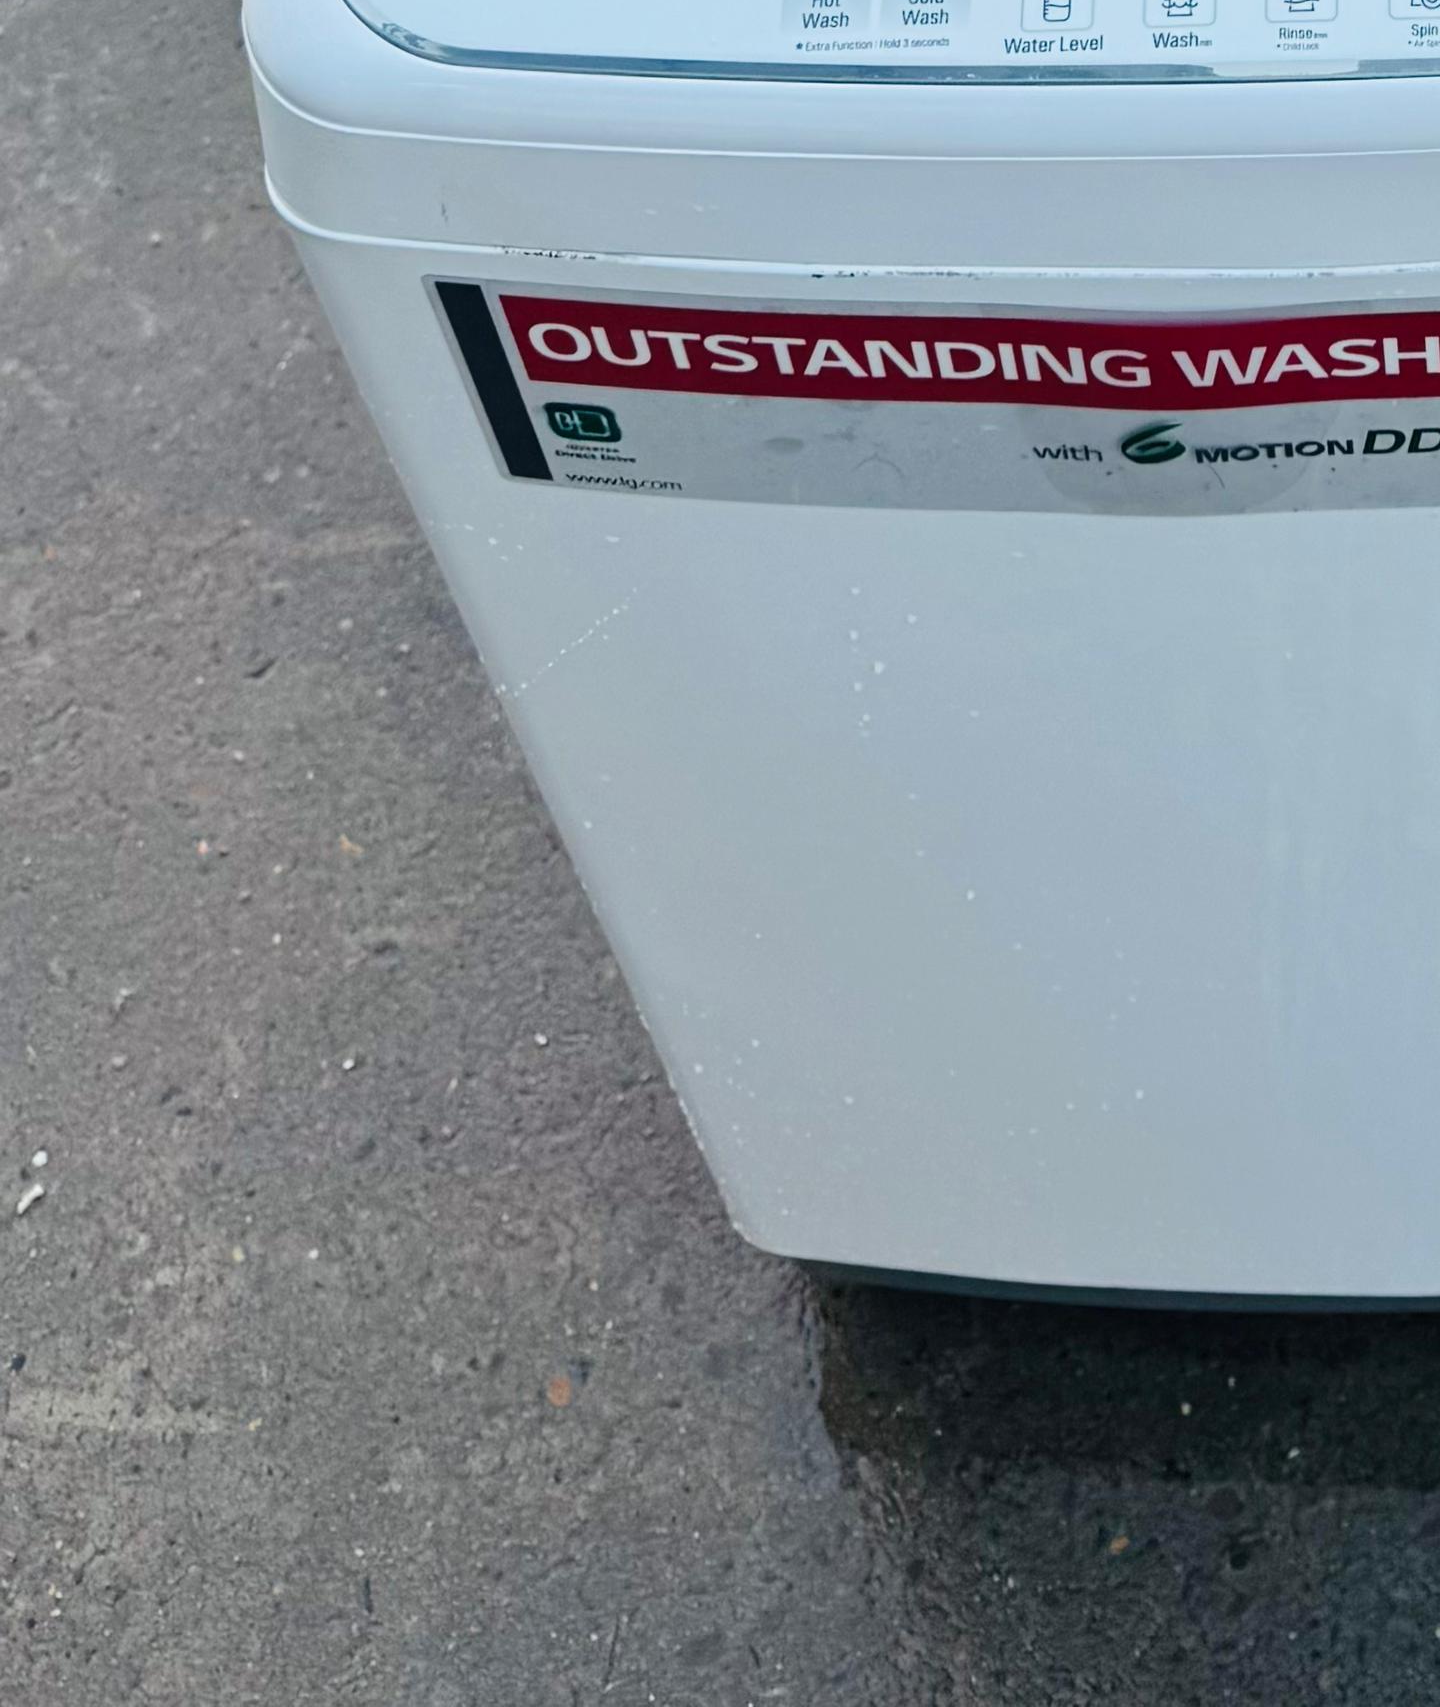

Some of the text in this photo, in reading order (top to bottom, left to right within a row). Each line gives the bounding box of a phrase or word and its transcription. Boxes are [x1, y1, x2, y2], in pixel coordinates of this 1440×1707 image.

[802, 13, 850, 29] Wash
[902, 10, 949, 27] Wash
[1279, 27, 1313, 40] Rinse
[1411, 23, 1439, 37] Spin
[832, 40, 872, 51] Function
[1004, 35, 1104, 54] Water Level
[1153, 32, 1199, 48] Wash
[528, 322, 1152, 388] OUTSTANDING
[1032, 444, 1104, 462] with
[1195, 438, 1355, 464] MOTION
[565, 473, 683, 491] www.lg.com
